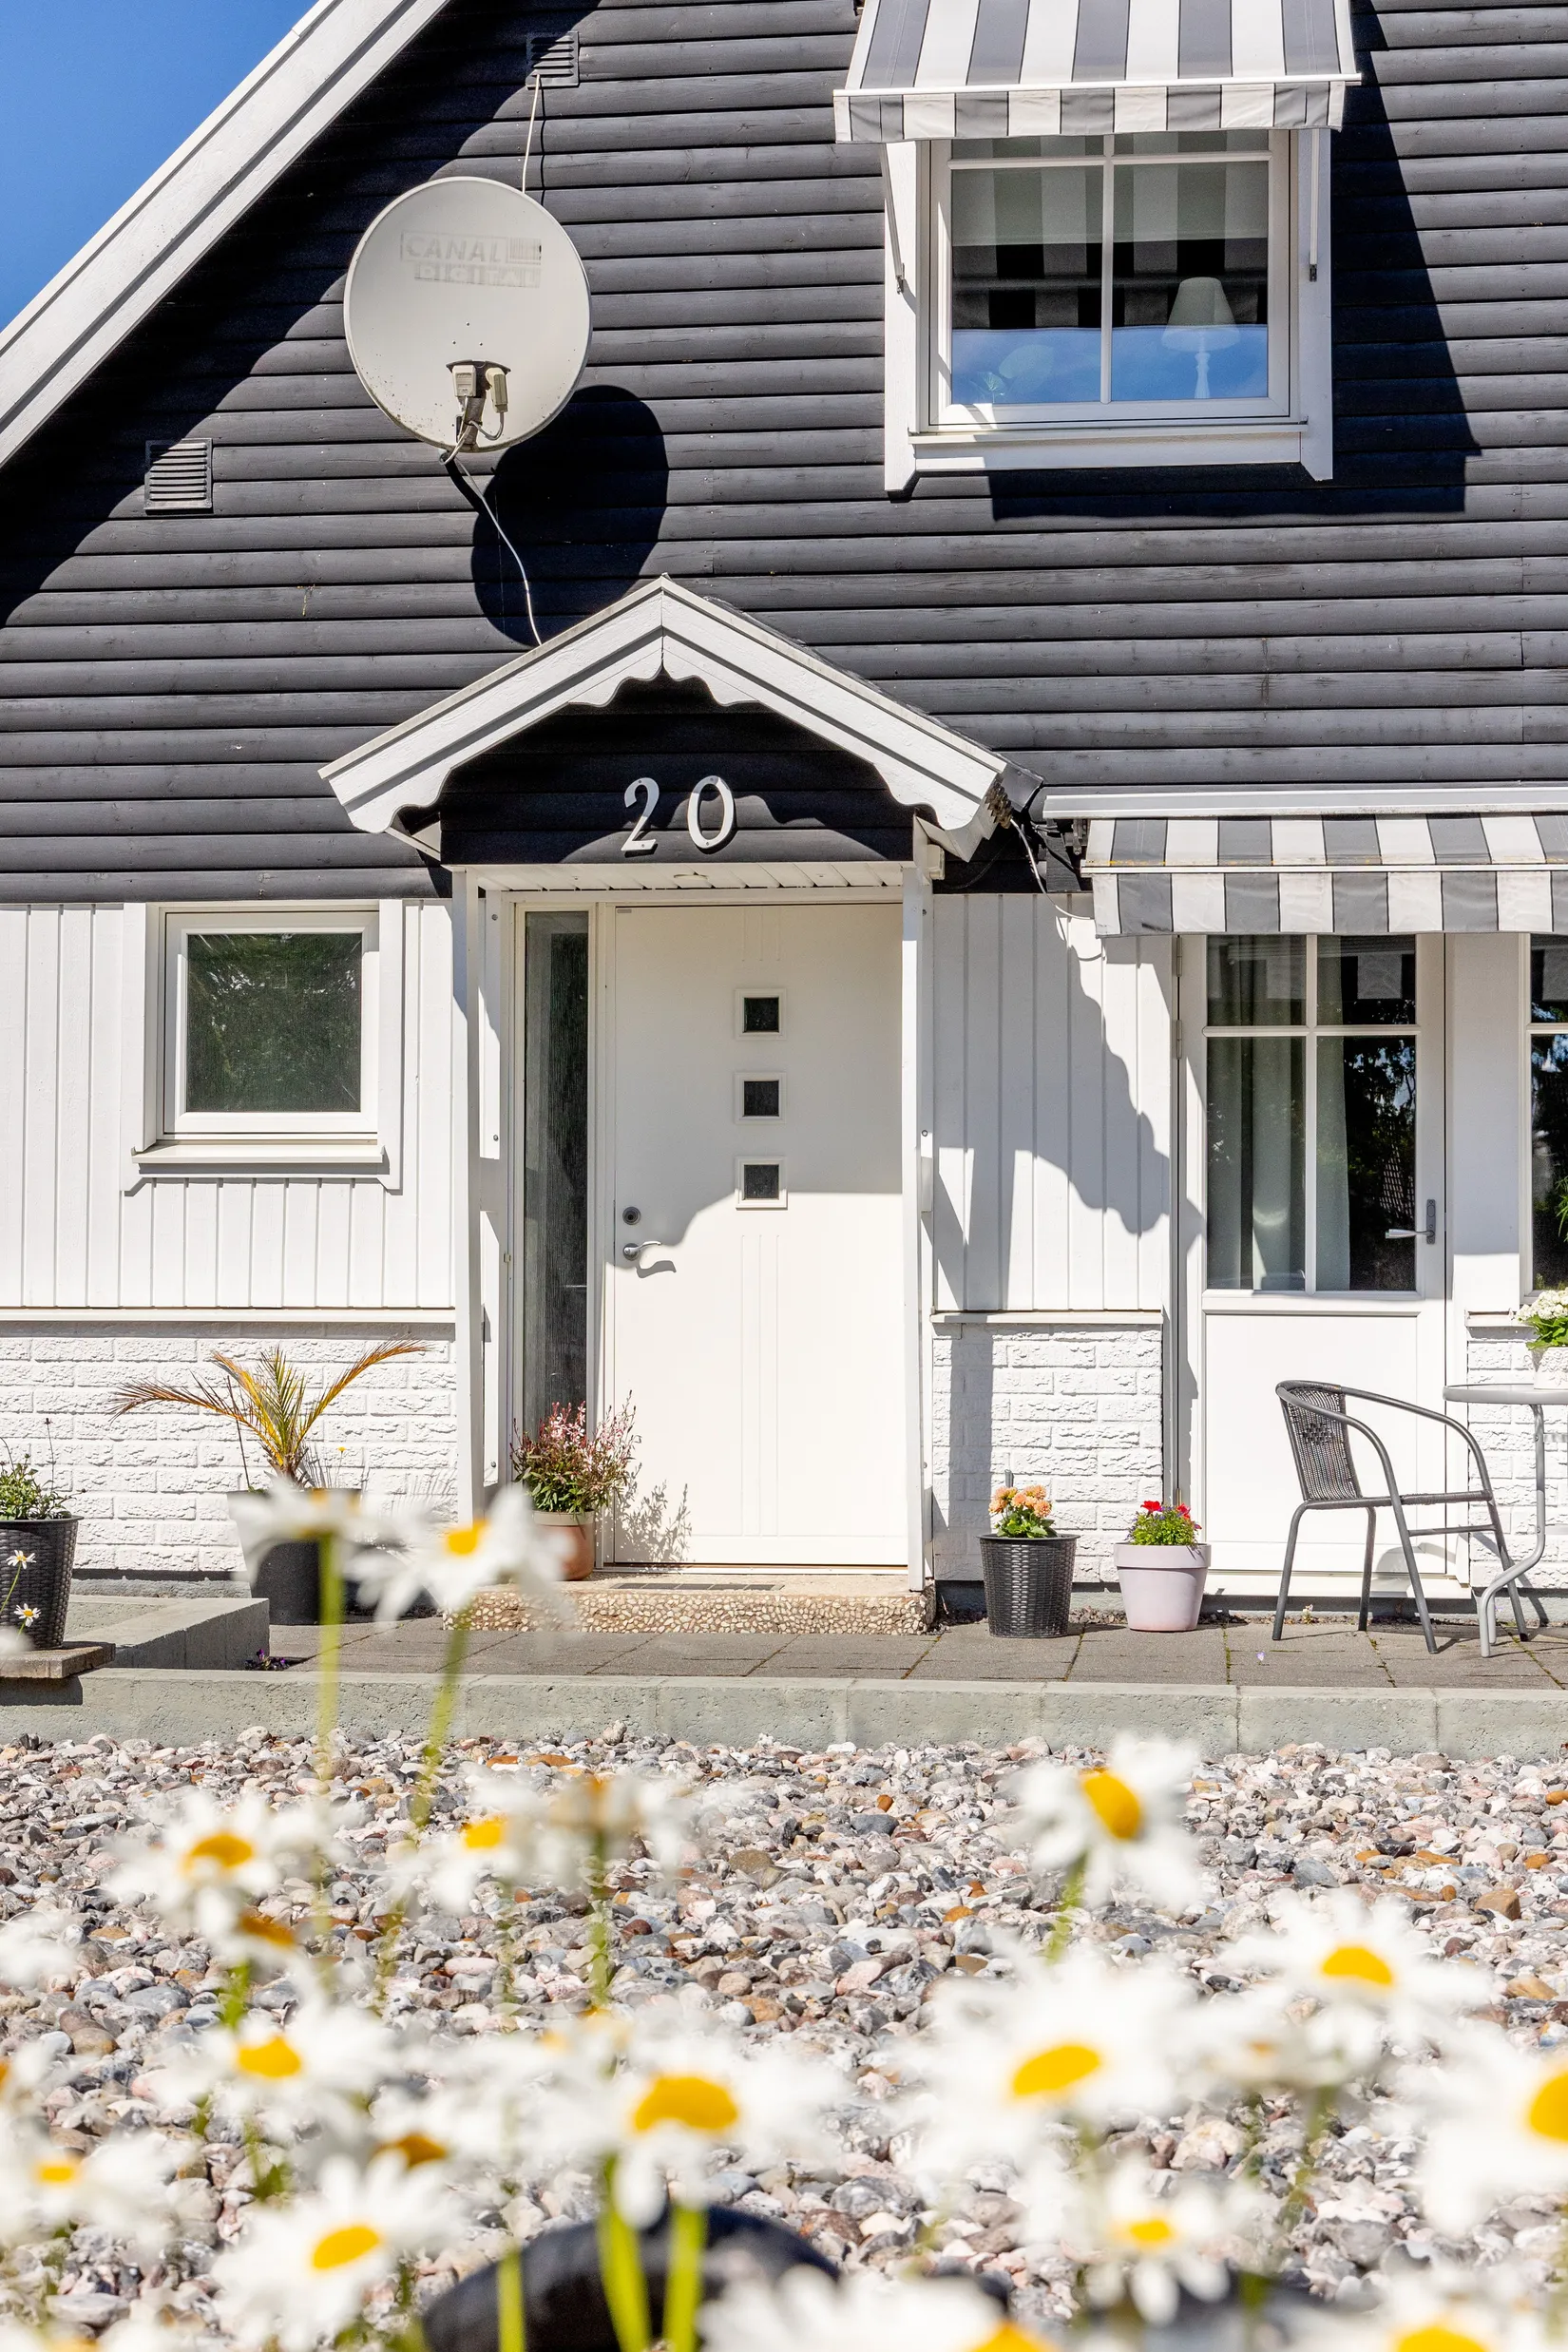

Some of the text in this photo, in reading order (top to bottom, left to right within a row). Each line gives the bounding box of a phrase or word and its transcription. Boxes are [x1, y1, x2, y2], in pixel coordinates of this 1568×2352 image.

[406, 236, 501, 262] CANAL
[419, 265, 536, 285] DIGITAL
[621, 774, 735, 851] 20
